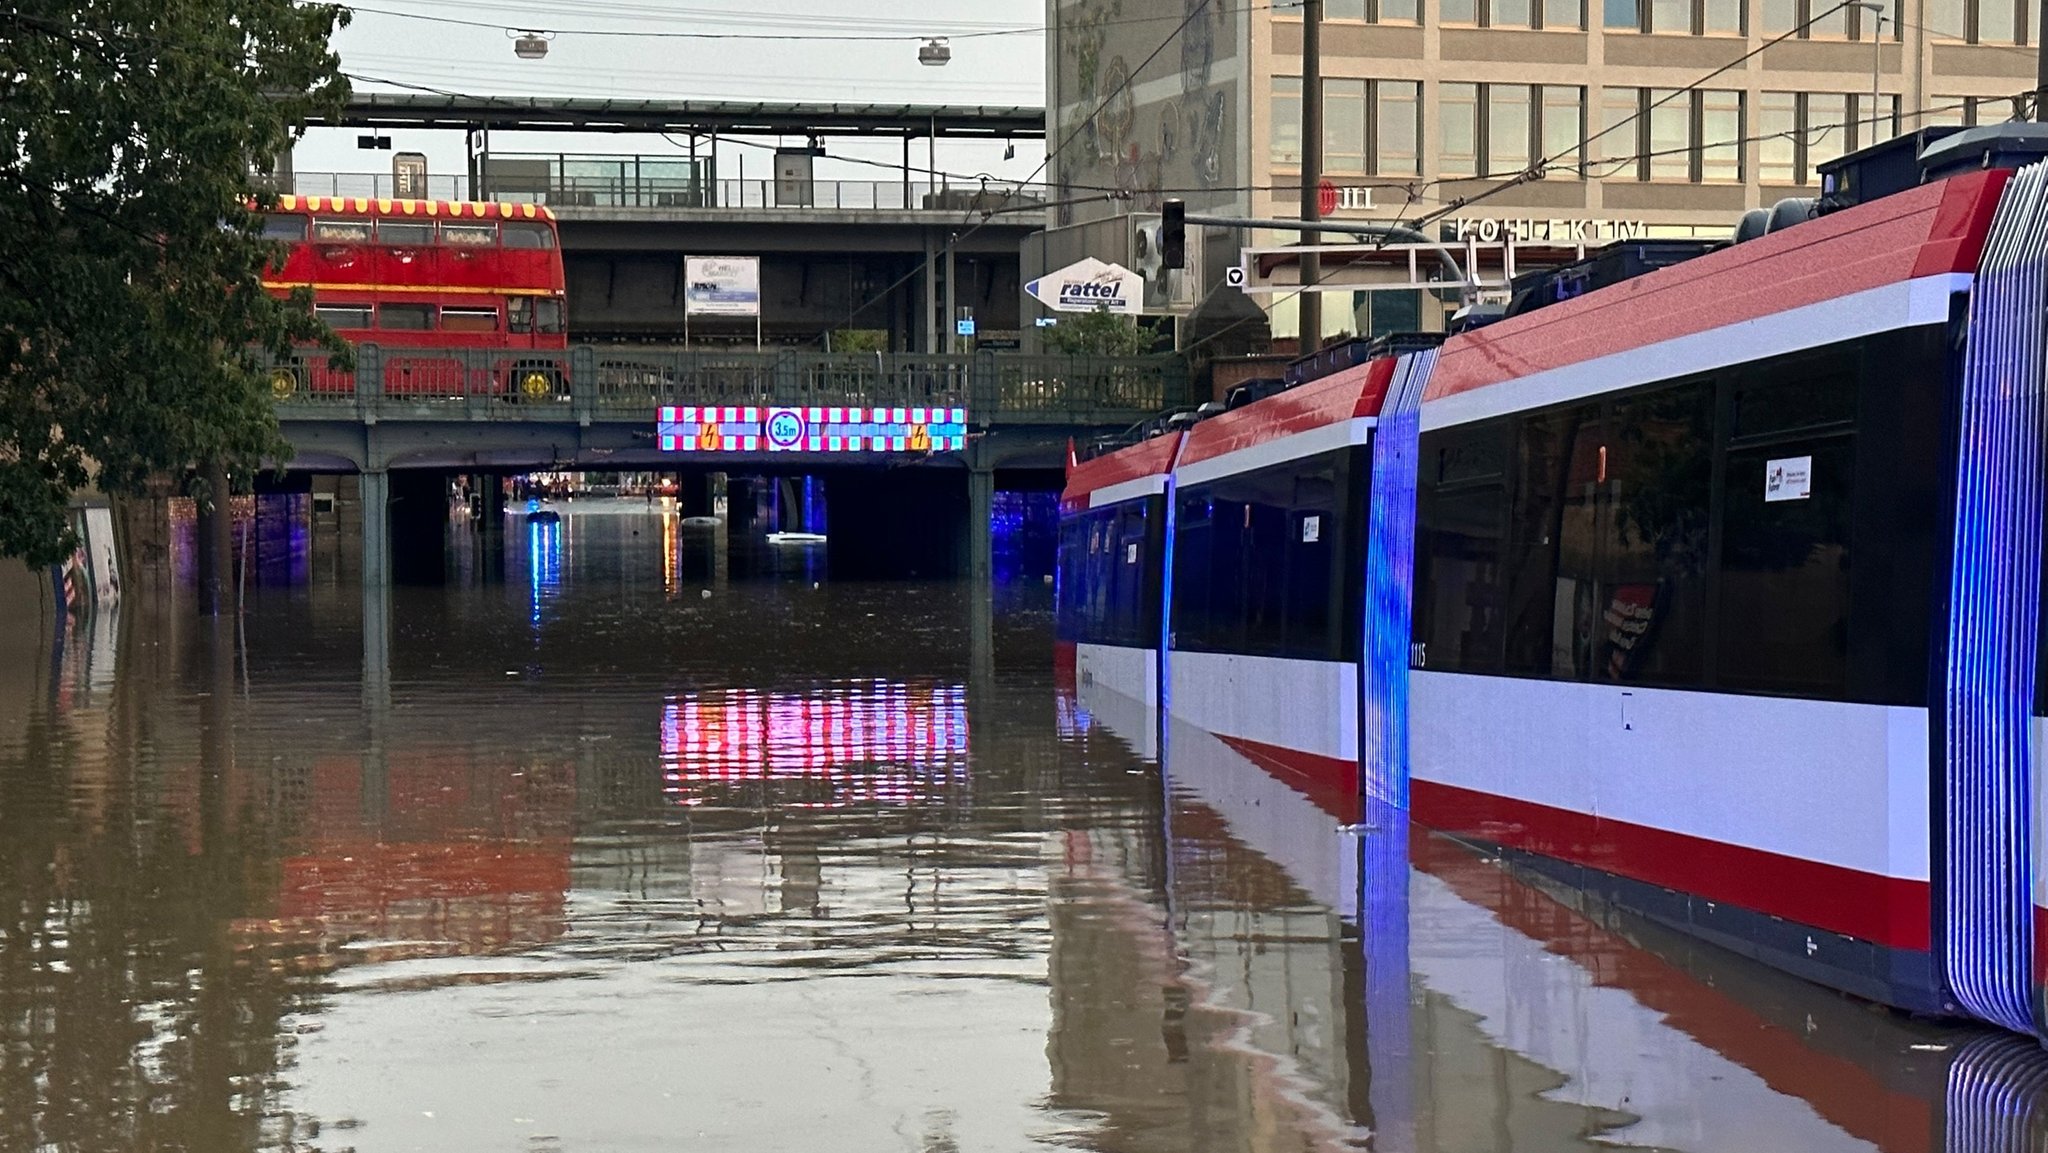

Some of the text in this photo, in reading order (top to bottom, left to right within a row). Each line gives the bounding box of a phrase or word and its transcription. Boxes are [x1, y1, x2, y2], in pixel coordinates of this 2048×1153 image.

[1337, 187, 1378, 210] JLL
[1456, 217, 1643, 242] KOHLEKTIV
[1060, 281, 1121, 298] rattel
